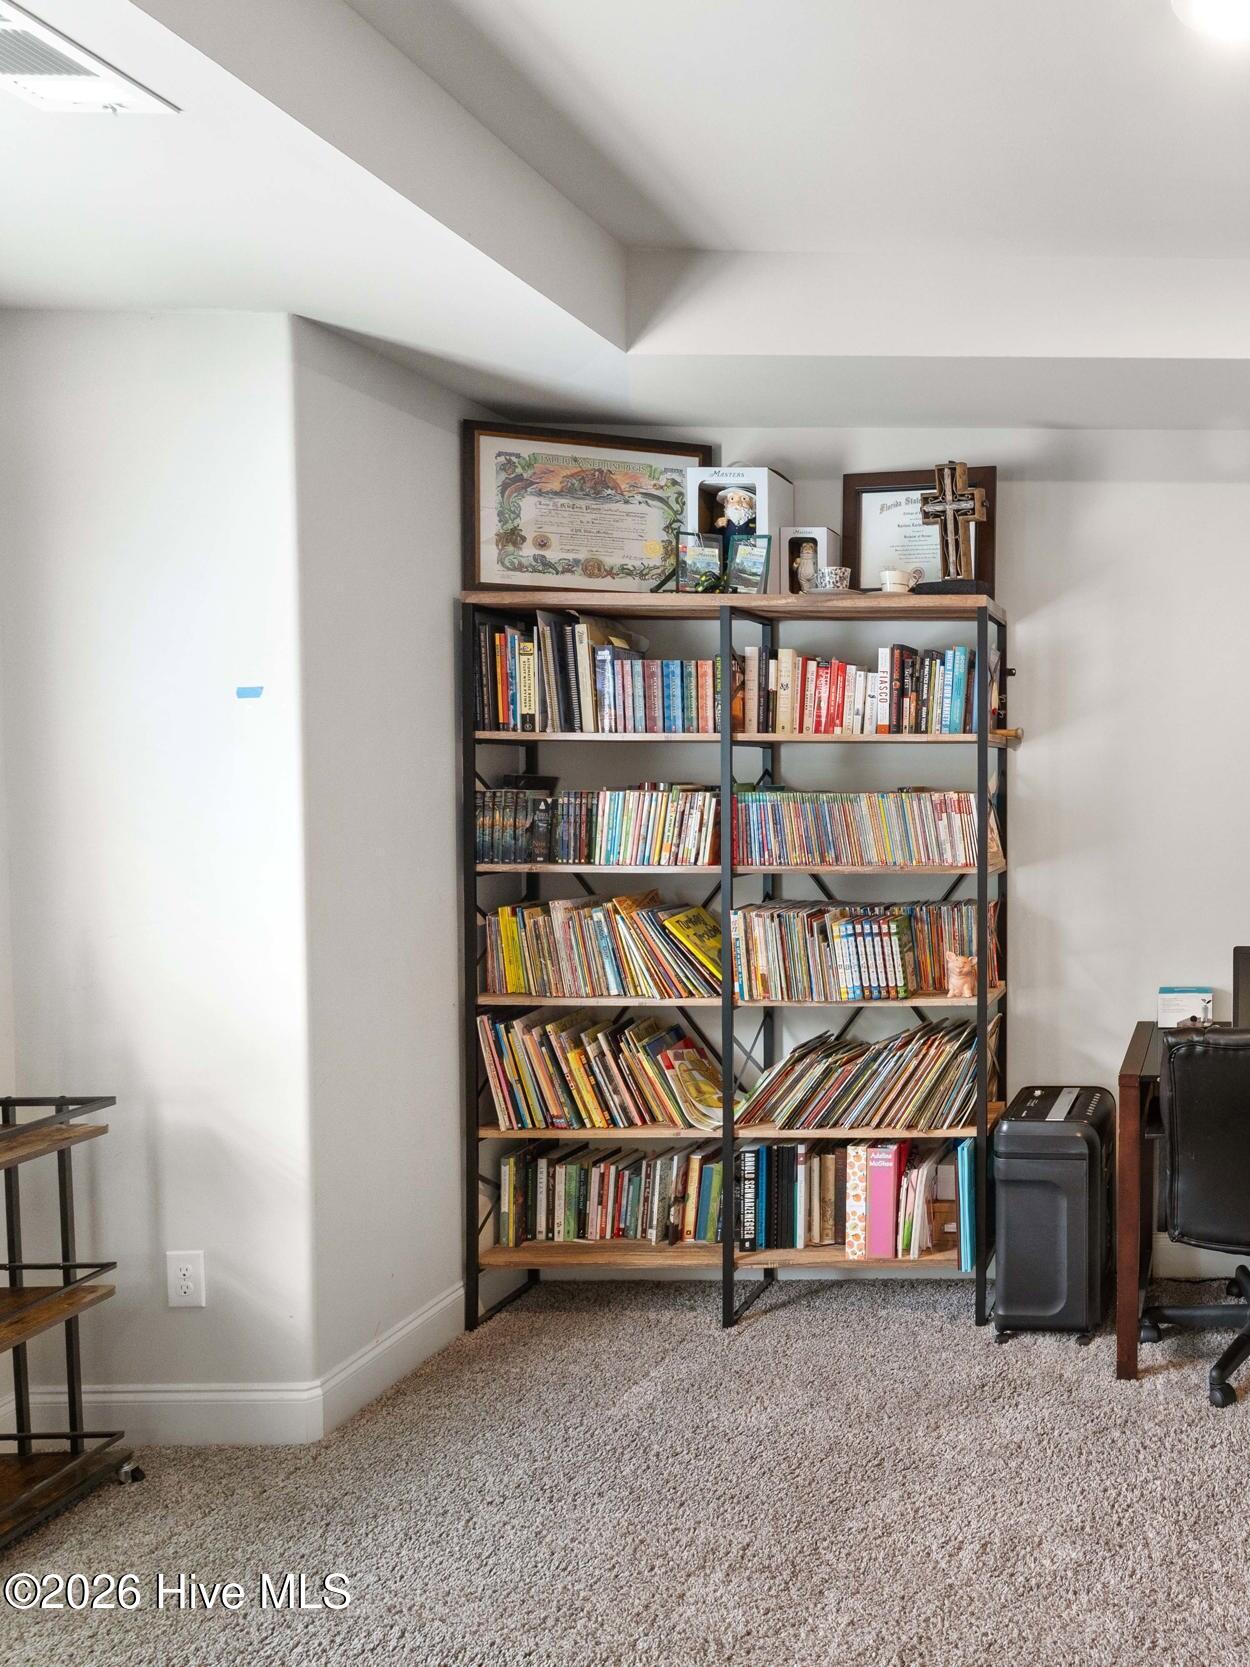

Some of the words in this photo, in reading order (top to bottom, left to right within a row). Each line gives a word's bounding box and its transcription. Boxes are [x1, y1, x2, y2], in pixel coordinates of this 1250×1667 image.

[878, 670, 888, 703] FIASCO
[944, 672, 952, 684] FREE
[942, 699, 951, 724] MARKETS
[745, 1153, 755, 1179] ARNOLD
[744, 1180, 755, 1239] SCHWARZENEGGER
